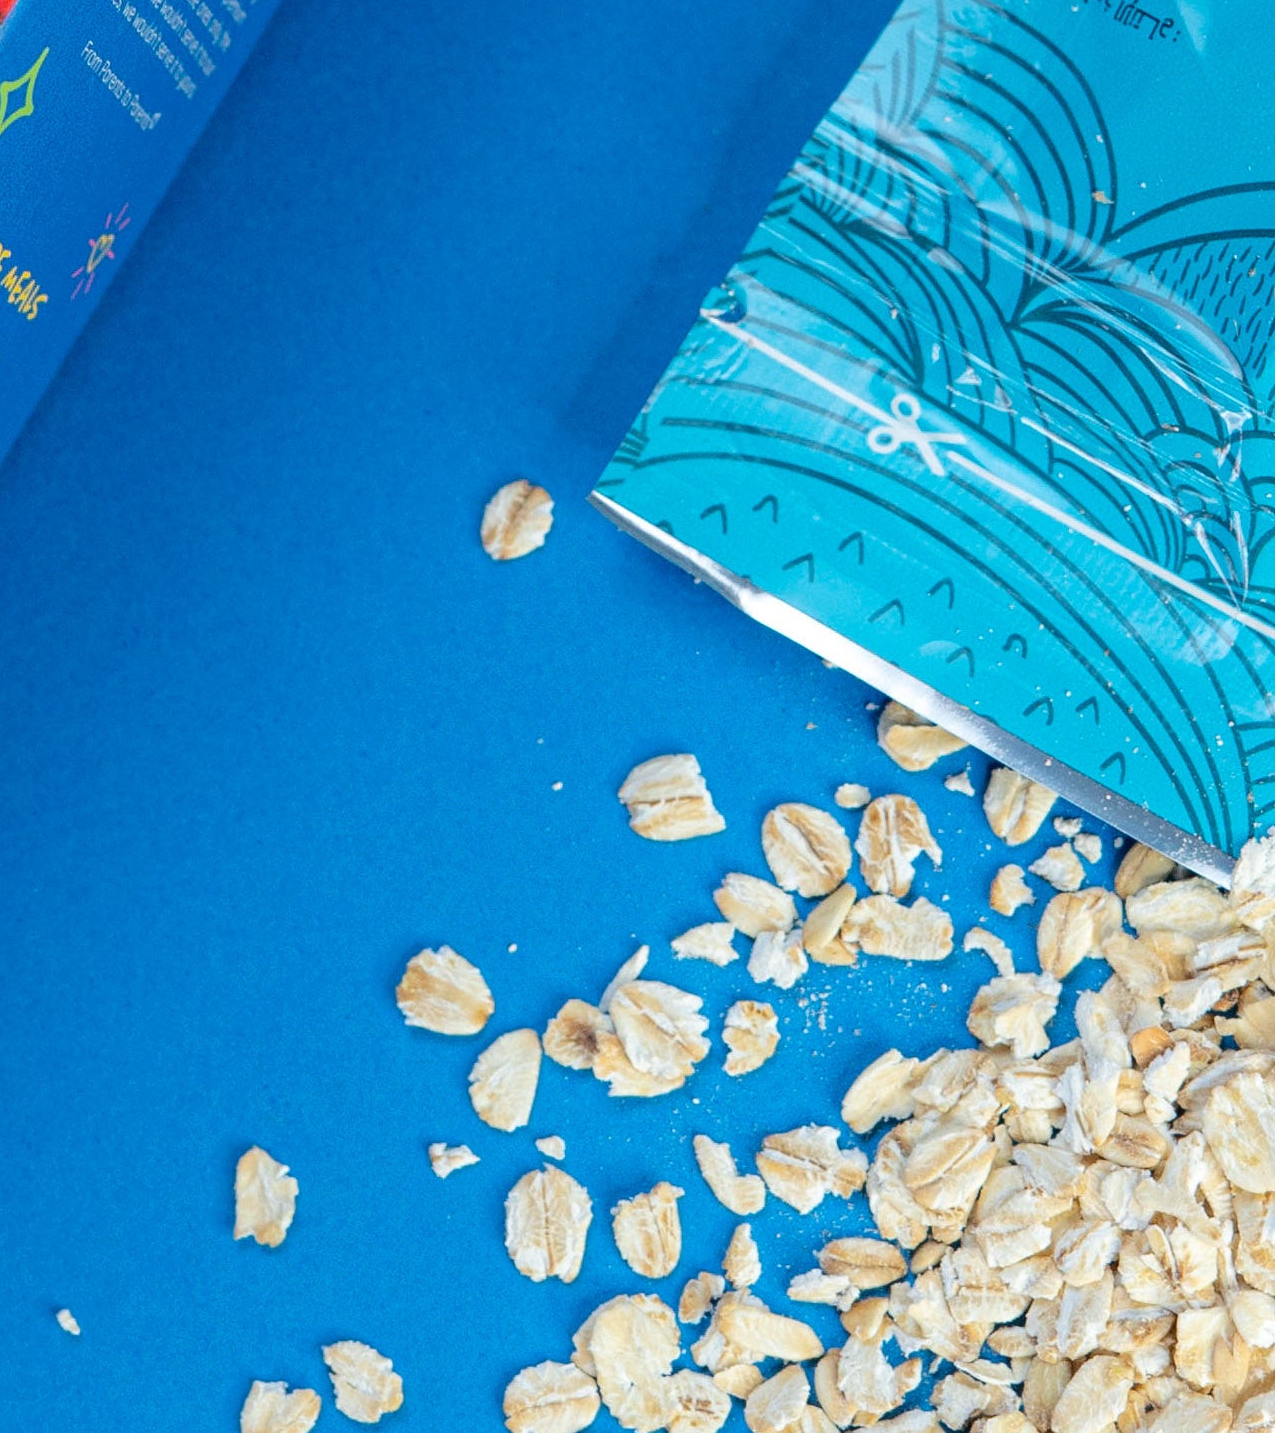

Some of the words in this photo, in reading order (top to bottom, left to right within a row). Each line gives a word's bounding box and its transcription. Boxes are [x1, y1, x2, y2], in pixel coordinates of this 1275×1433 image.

[121, 2, 137, 22] we
[131, 14, 162, 49] wouldn't
[80, 39, 103, 71] From
[98, 59, 126, 99] Parents
[119, 88, 132, 107] to
[0, 266, 48, 320] MEALS
